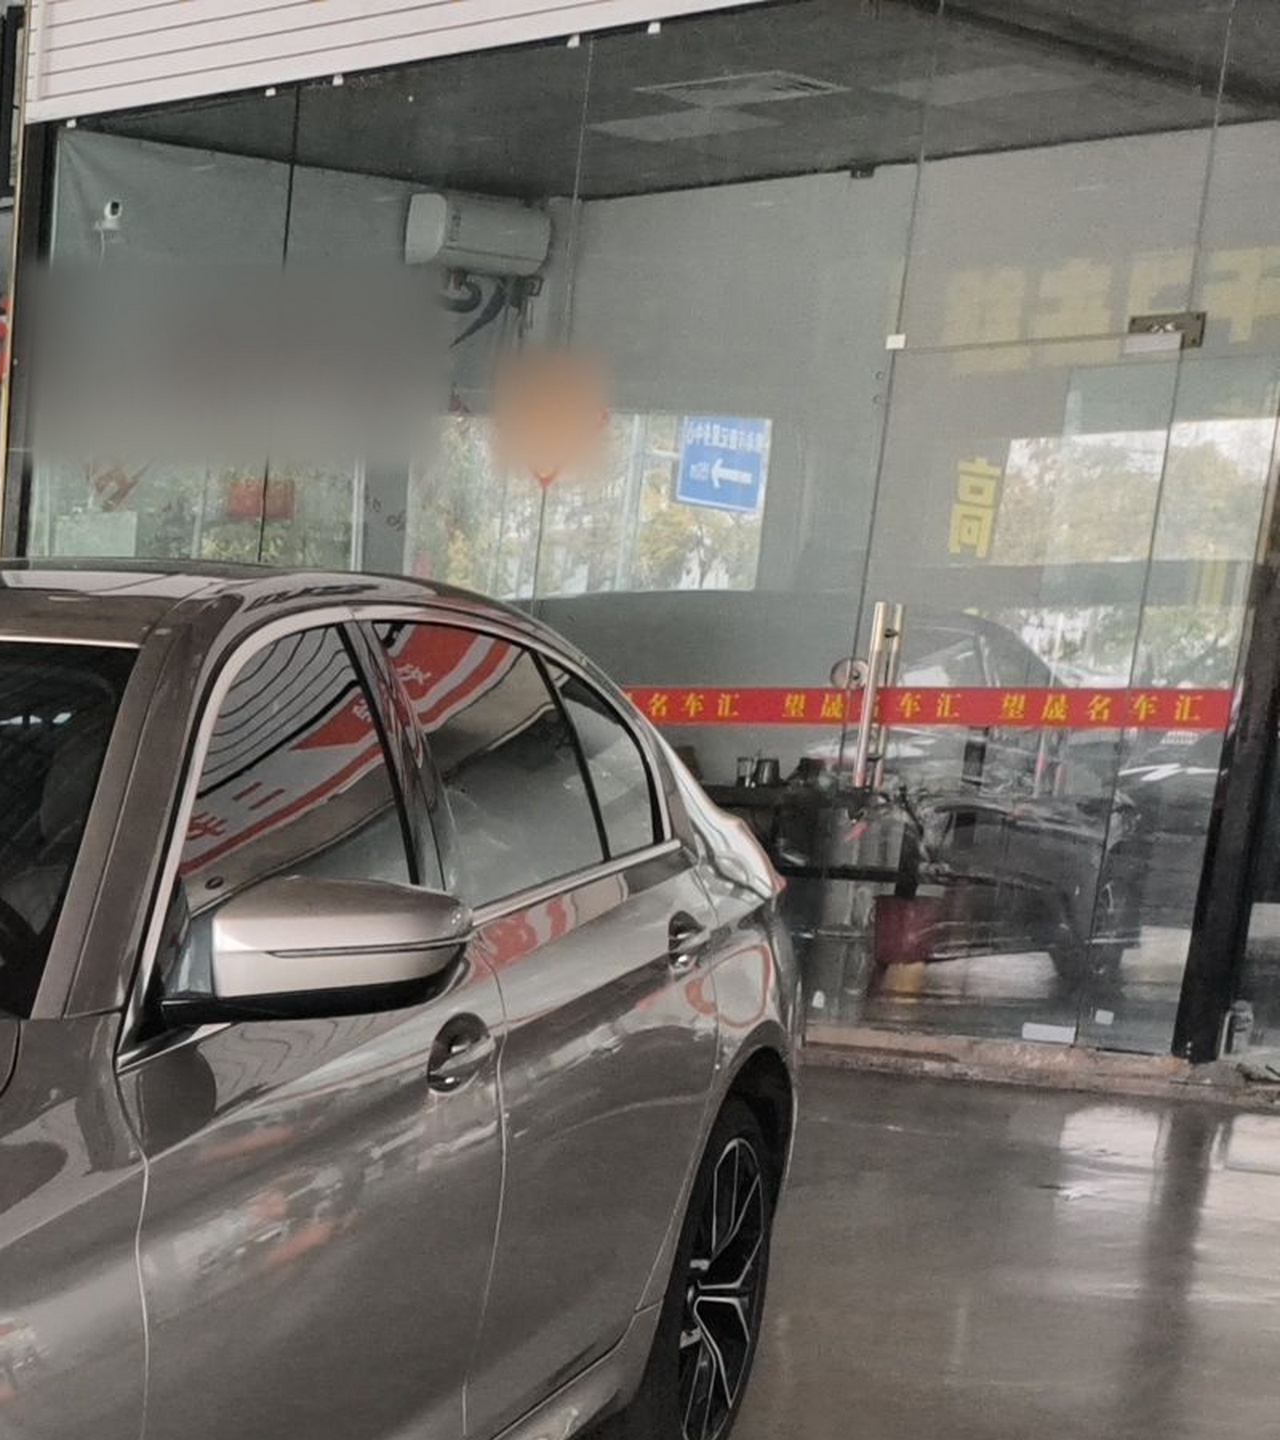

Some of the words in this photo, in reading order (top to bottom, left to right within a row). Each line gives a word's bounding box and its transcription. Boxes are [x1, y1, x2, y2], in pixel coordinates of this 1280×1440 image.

[626, 692, 740, 718] 名车汇
[782, 691, 961, 719] 望晟车汇
[1000, 693, 1204, 722] 望晟名车汇
